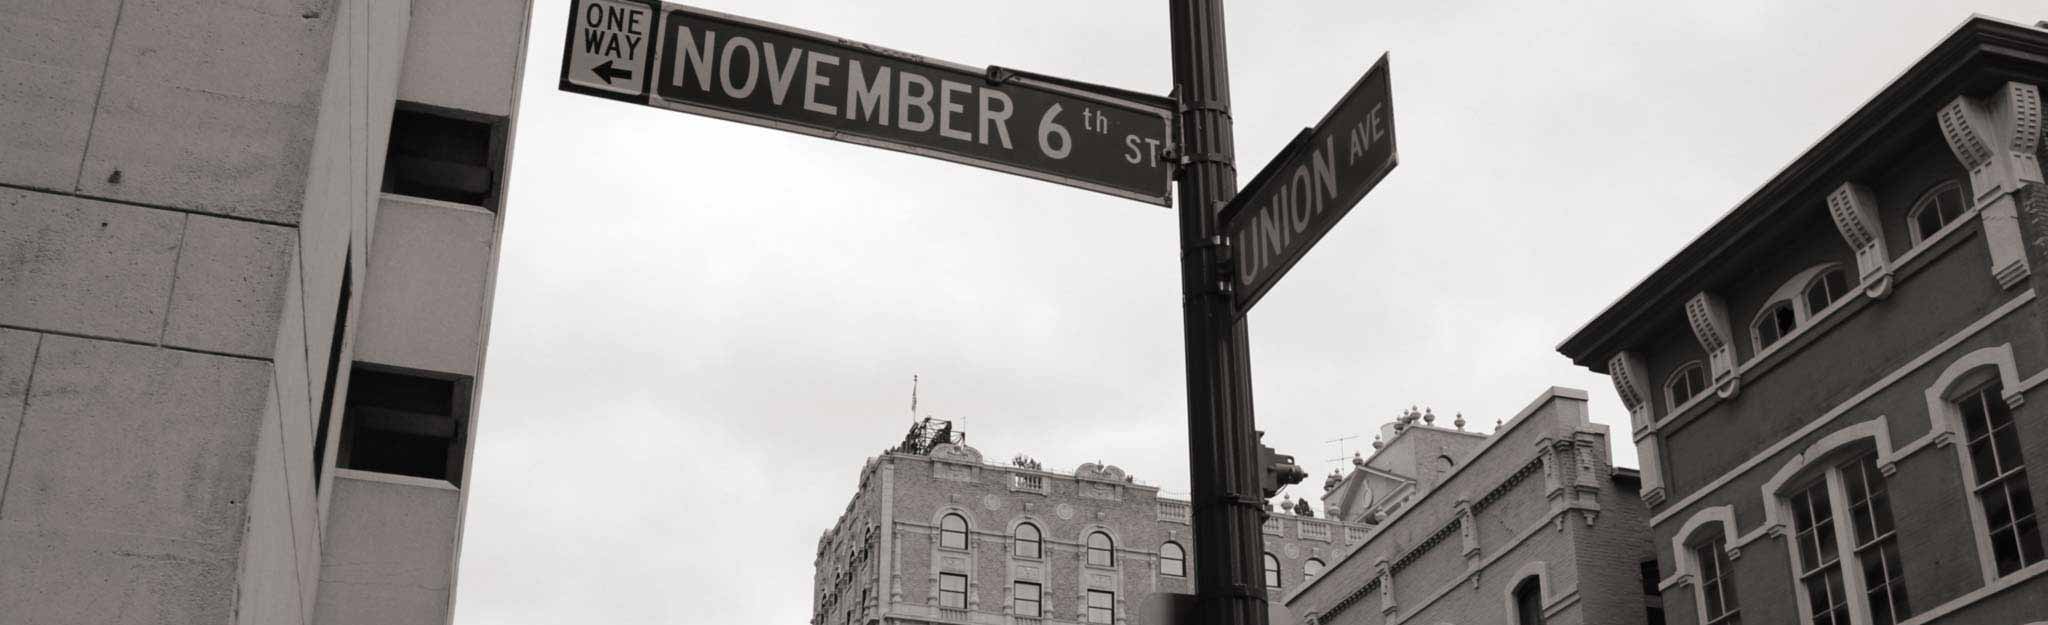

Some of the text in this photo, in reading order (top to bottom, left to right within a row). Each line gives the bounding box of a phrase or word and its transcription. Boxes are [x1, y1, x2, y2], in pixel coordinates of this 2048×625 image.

[584, 28, 642, 60] WAY
[586, 3, 644, 35] ONE
[672, 25, 1160, 168] NOVEMBER 6th ST
[1239, 101, 1385, 286] UNION AVE
